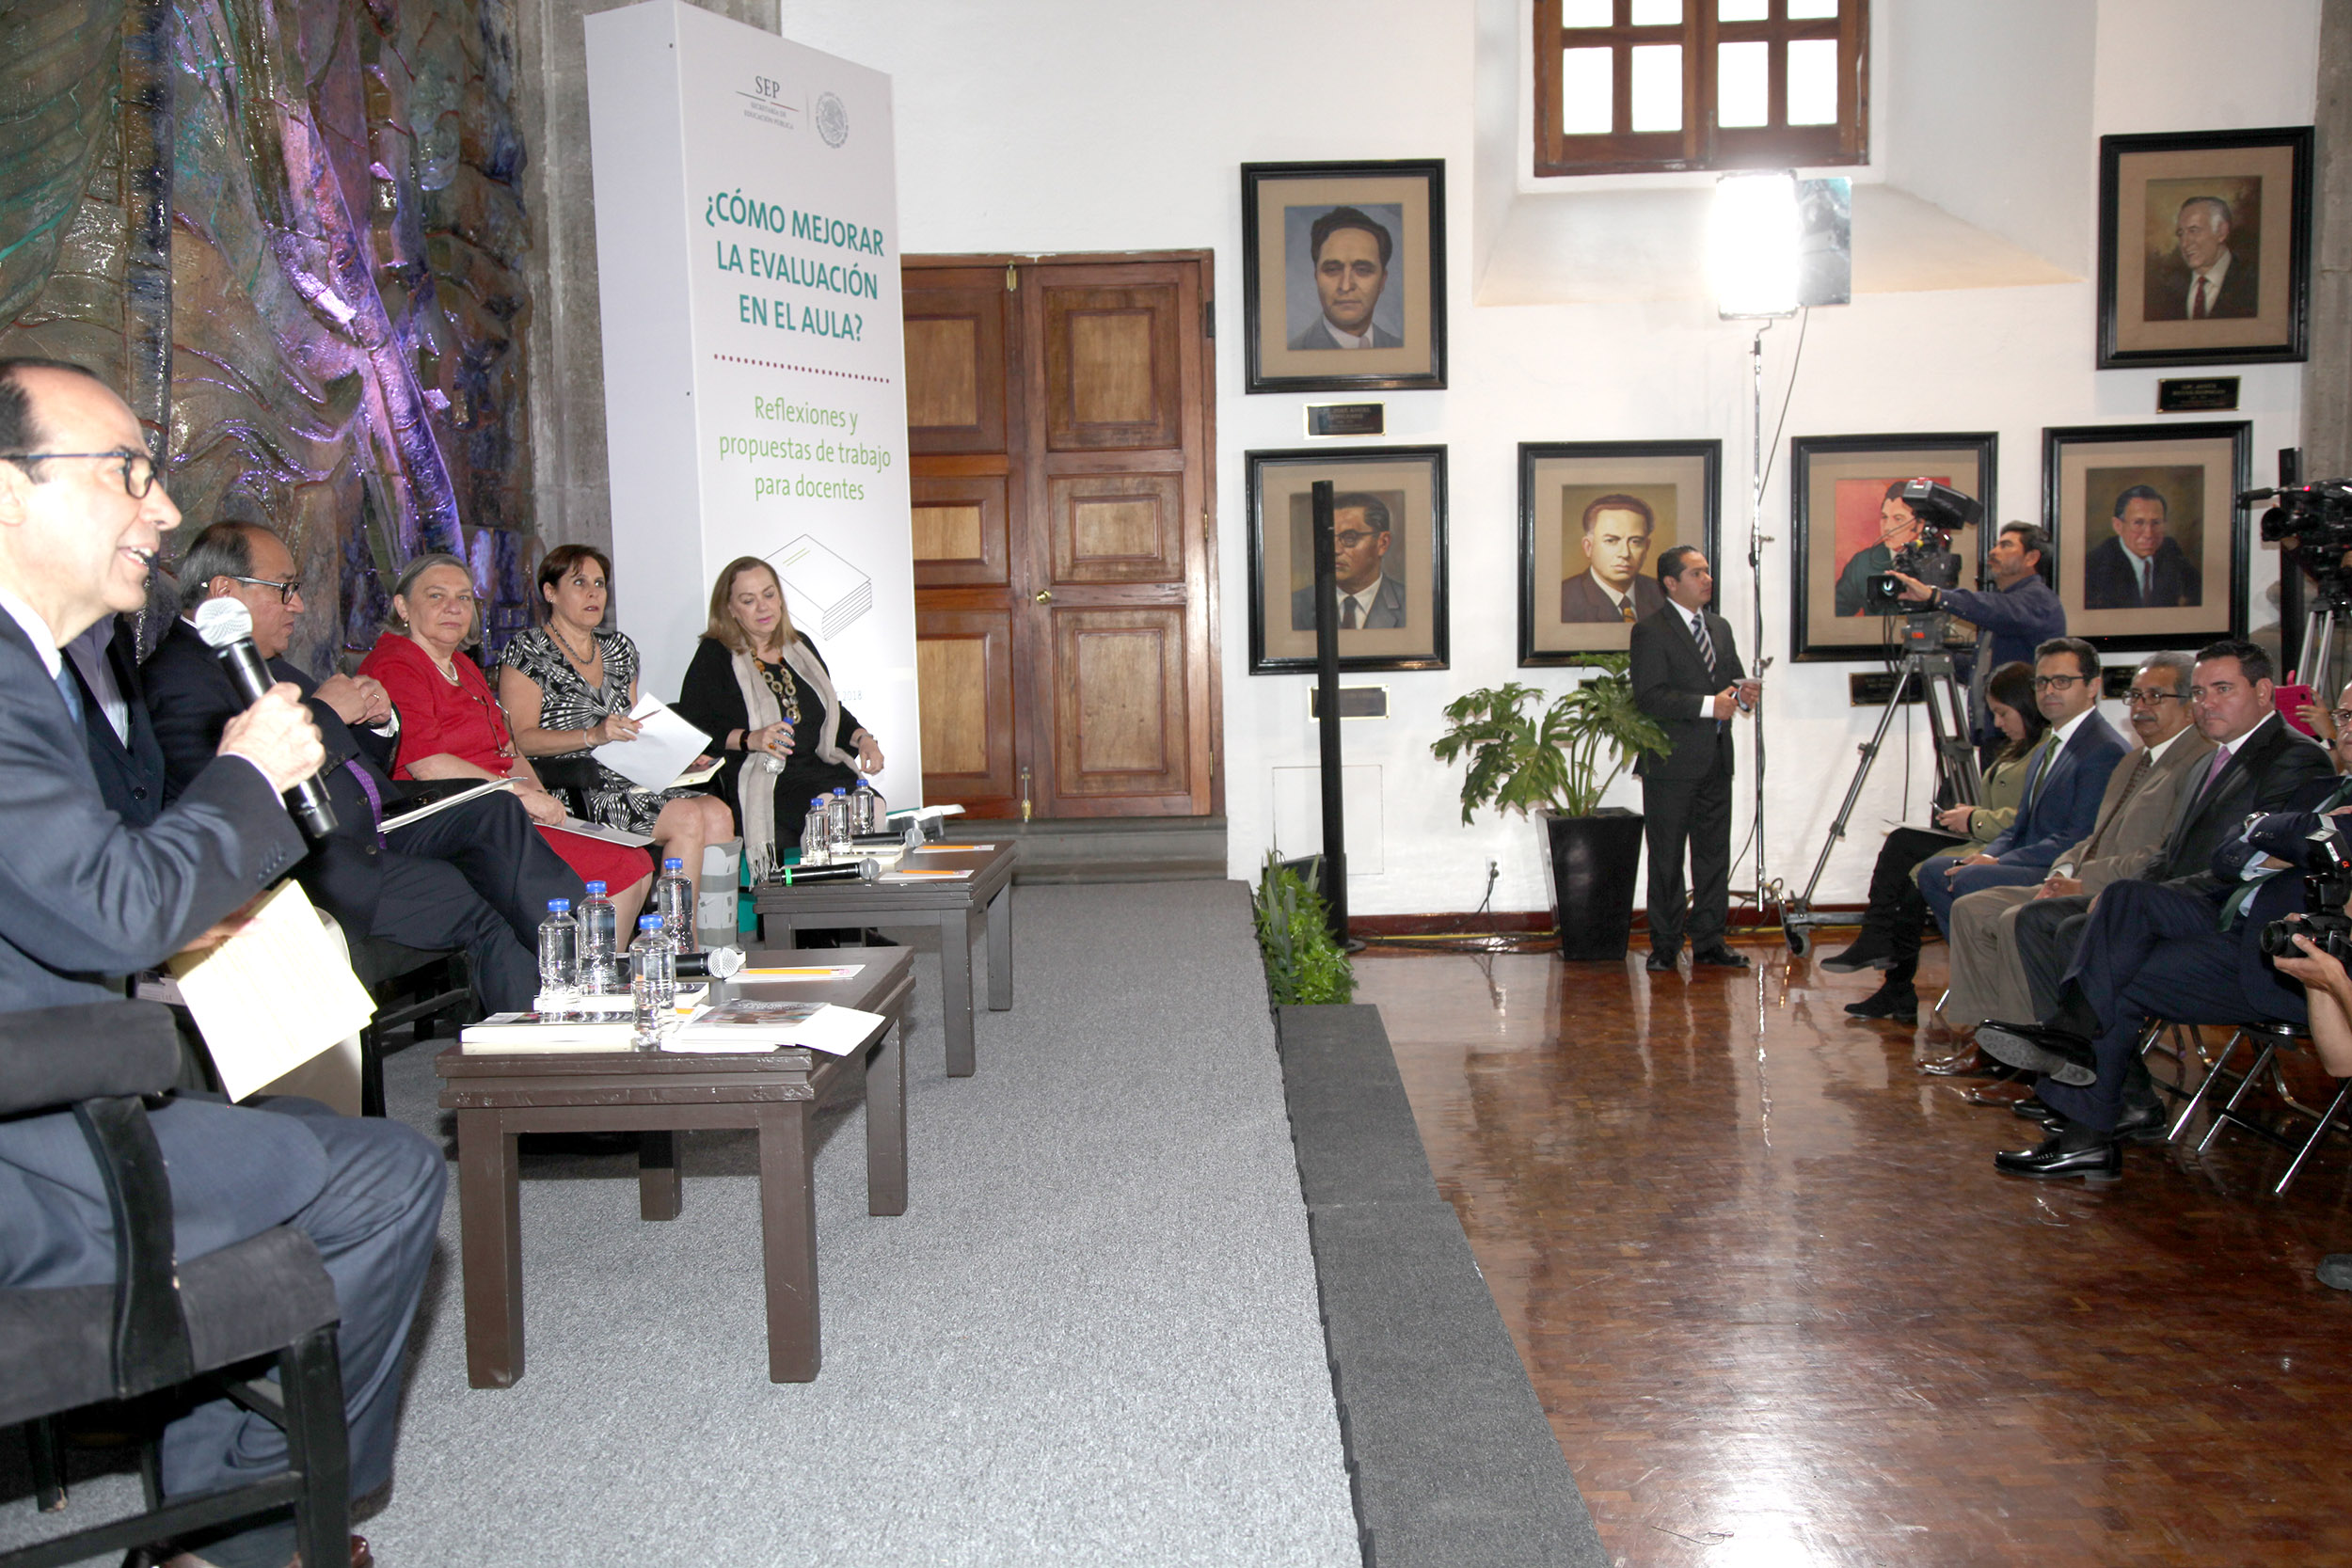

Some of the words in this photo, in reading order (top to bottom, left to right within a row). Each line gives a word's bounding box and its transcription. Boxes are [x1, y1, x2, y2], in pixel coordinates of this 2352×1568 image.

[755, 75, 781, 99] SEP
[706, 187, 786, 234] ¿CÓMO
[791, 210, 884, 258] MEJORAR
[717, 240, 745, 275] LA
[750, 247, 878, 300] EVALUACIÓN
[739, 293, 768, 327] EN
[774, 300, 797, 331] EL
[802, 306, 864, 342] AULA?
[755, 395, 847, 428] Reflexiones
[849, 412, 859, 436] y
[719, 436, 813, 464] propuestas
[816, 438, 834, 463] de
[837, 441, 892, 474] trabajo
[755, 476, 791, 501] para
[795, 473, 866, 501] docentes
